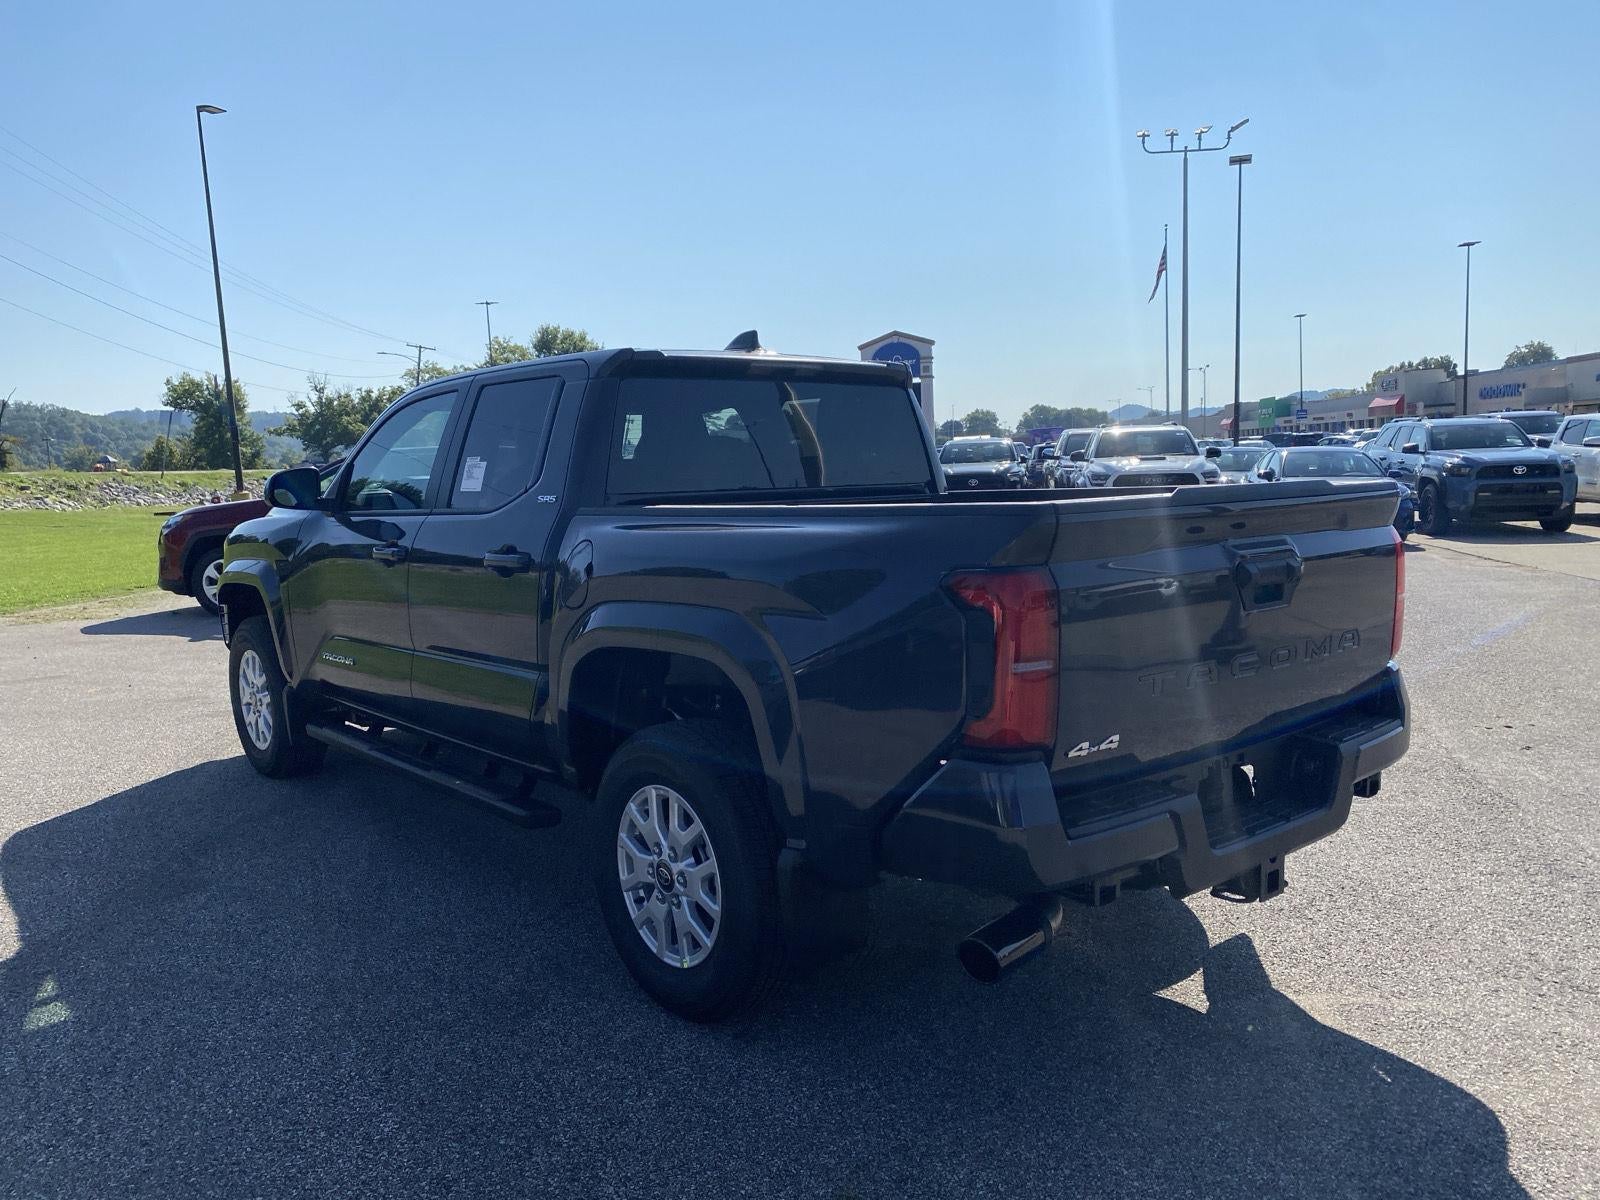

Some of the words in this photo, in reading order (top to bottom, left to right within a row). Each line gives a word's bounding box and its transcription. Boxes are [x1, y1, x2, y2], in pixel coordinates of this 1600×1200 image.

[537, 495, 556, 503] SR5
[322, 651, 354, 665] TACOMA
[1137, 628, 1360, 696] TACOMA
